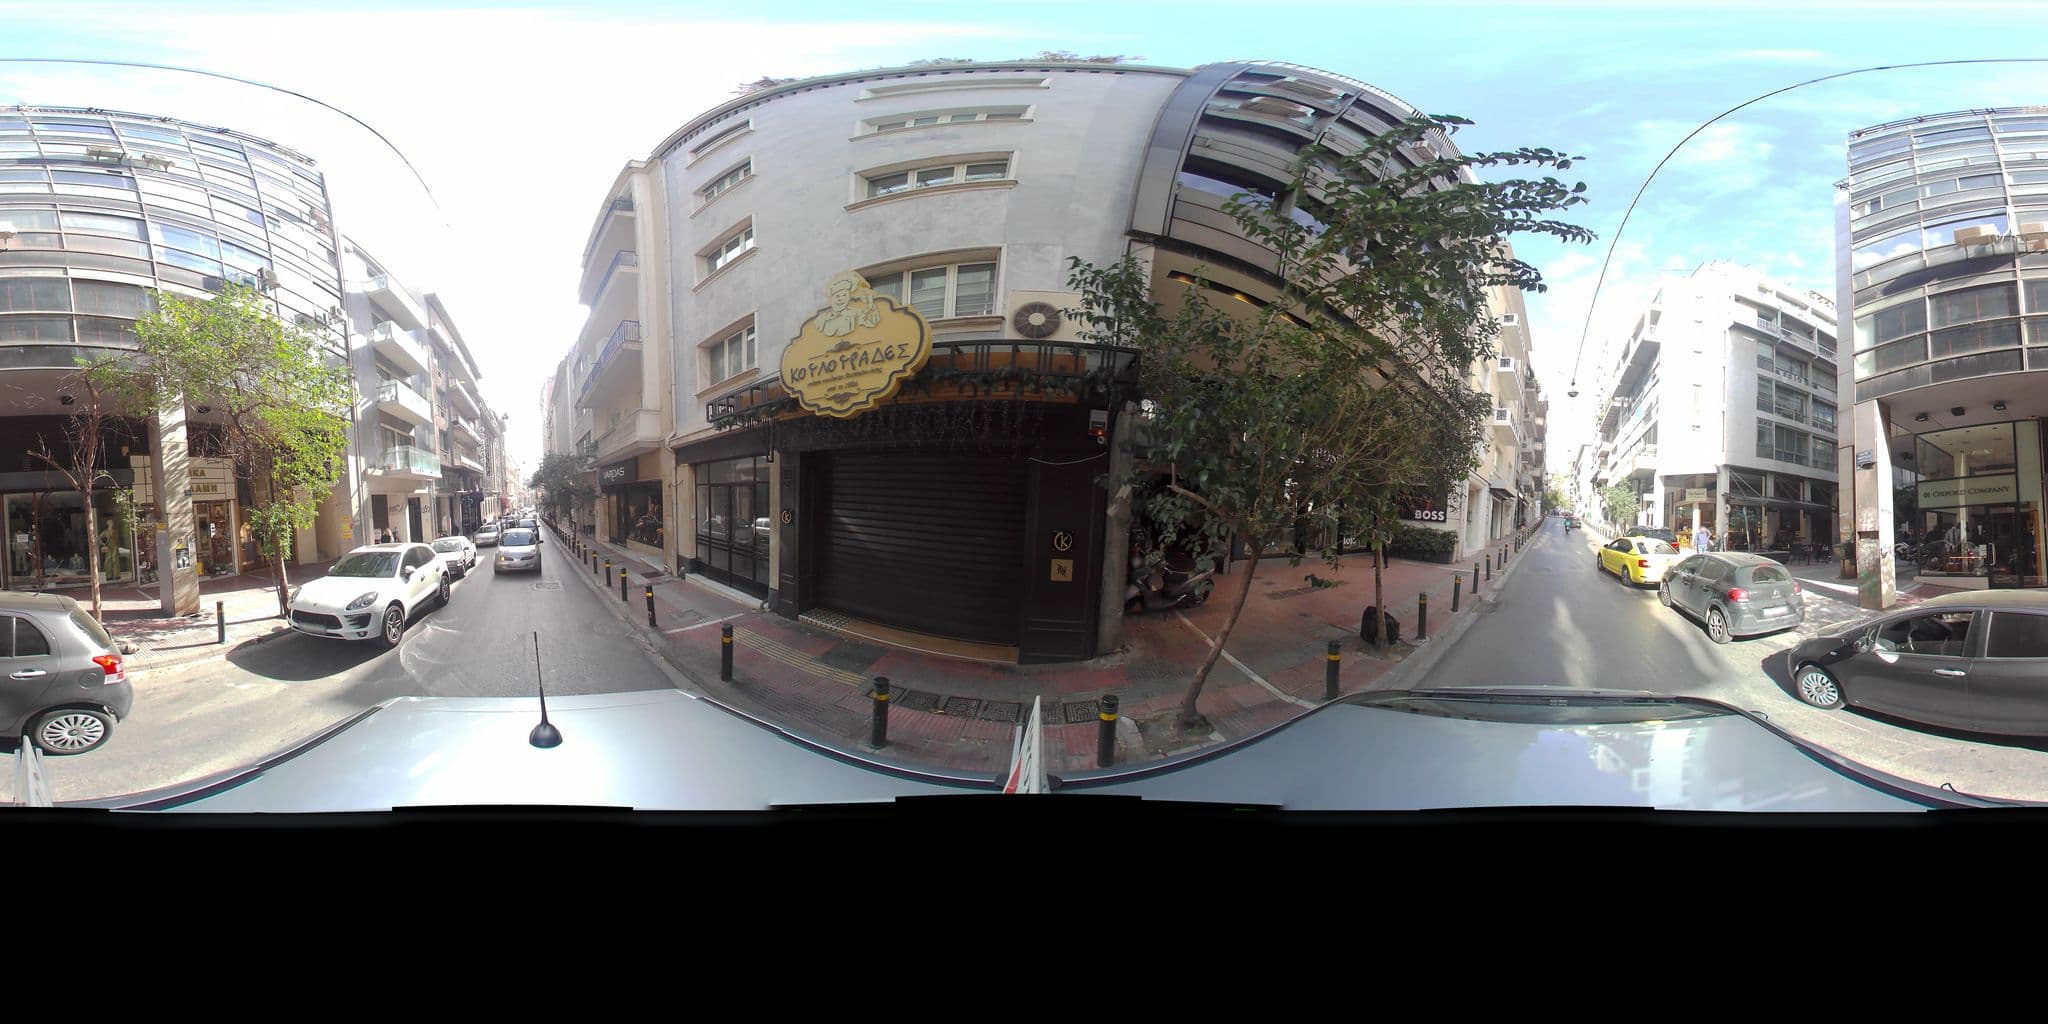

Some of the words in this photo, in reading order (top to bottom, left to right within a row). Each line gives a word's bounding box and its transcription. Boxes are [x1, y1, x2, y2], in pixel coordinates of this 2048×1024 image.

[790, 343, 910, 384] ΚΟΥΛΟΥΡΑΔΕΣ
[1932, 489, 1967, 497] OXFORD
[1967, 486, 2010, 495] COMPANY
[1414, 510, 1445, 521] BOSS
